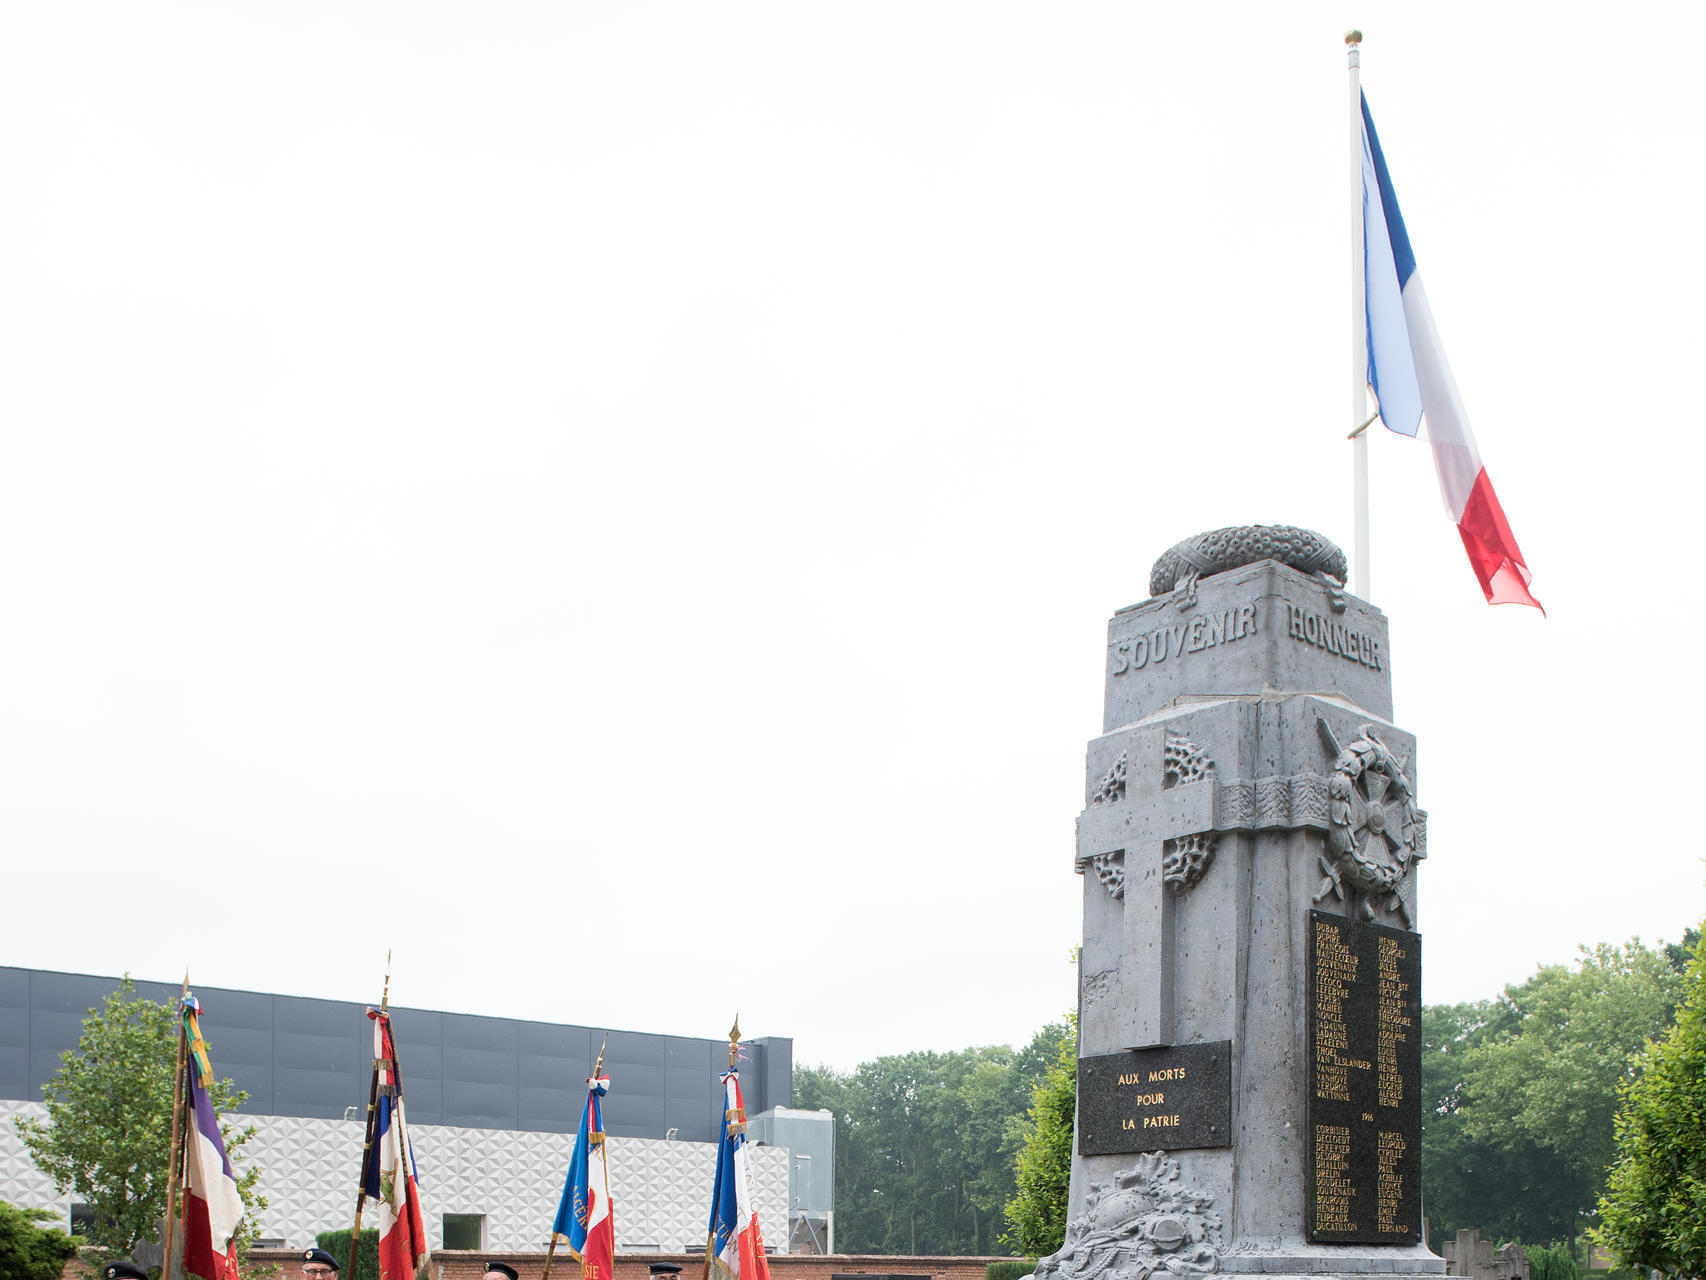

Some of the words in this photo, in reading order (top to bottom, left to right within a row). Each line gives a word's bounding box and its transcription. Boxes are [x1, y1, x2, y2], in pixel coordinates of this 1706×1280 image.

[1112, 604, 1258, 675] SOUVENIR
[1287, 605, 1382, 671] HONNEUR
[1316, 932, 1341, 944] DUPIRE
[1378, 945, 1406, 959] GEORGES
[1378, 936, 1398, 948] HENRI
[1378, 953, 1397, 965] LOUIS
[1316, 957, 1357, 973] JOUVENAUX
[1378, 962, 1398, 973] JULES
[1316, 966, 1357, 982] JOUVENAUX
[1379, 979, 1396, 989] JEAN
[1316, 975, 1343, 989] LECOCQ
[1379, 988, 1401, 999] VICTOR
[1379, 997, 1396, 1007] JEAN
[1378, 1005, 1401, 1016] JOSEPH
[1378, 1038, 1396, 1048] LOUIS
[1378, 1047, 1396, 1057] LOUIS
[1378, 1055, 1398, 1065] HENRI
[1378, 1063, 1398, 1074] HENRI
[1118, 1072, 1139, 1085] AUX
[1148, 1067, 1186, 1082] MORTS
[1378, 1073, 1403, 1083] ALFRED
[1137, 1093, 1164, 1106] POUR
[1378, 1090, 1403, 1100] ALFRED
[1379, 1097, 1399, 1108] HENRI
[1122, 1119, 1135, 1129] LA
[1143, 1114, 1180, 1128] PATRIE
[1378, 1131, 1404, 1141] MARCEL
[1378, 1157, 1398, 1166] JULES
[1378, 1165, 1394, 1174] PAUL
[1316, 1186, 1357, 1197] JOUVENAUX
[1378, 1199, 1398, 1208] HENRI
[1378, 1215, 1394, 1224] PAUL
